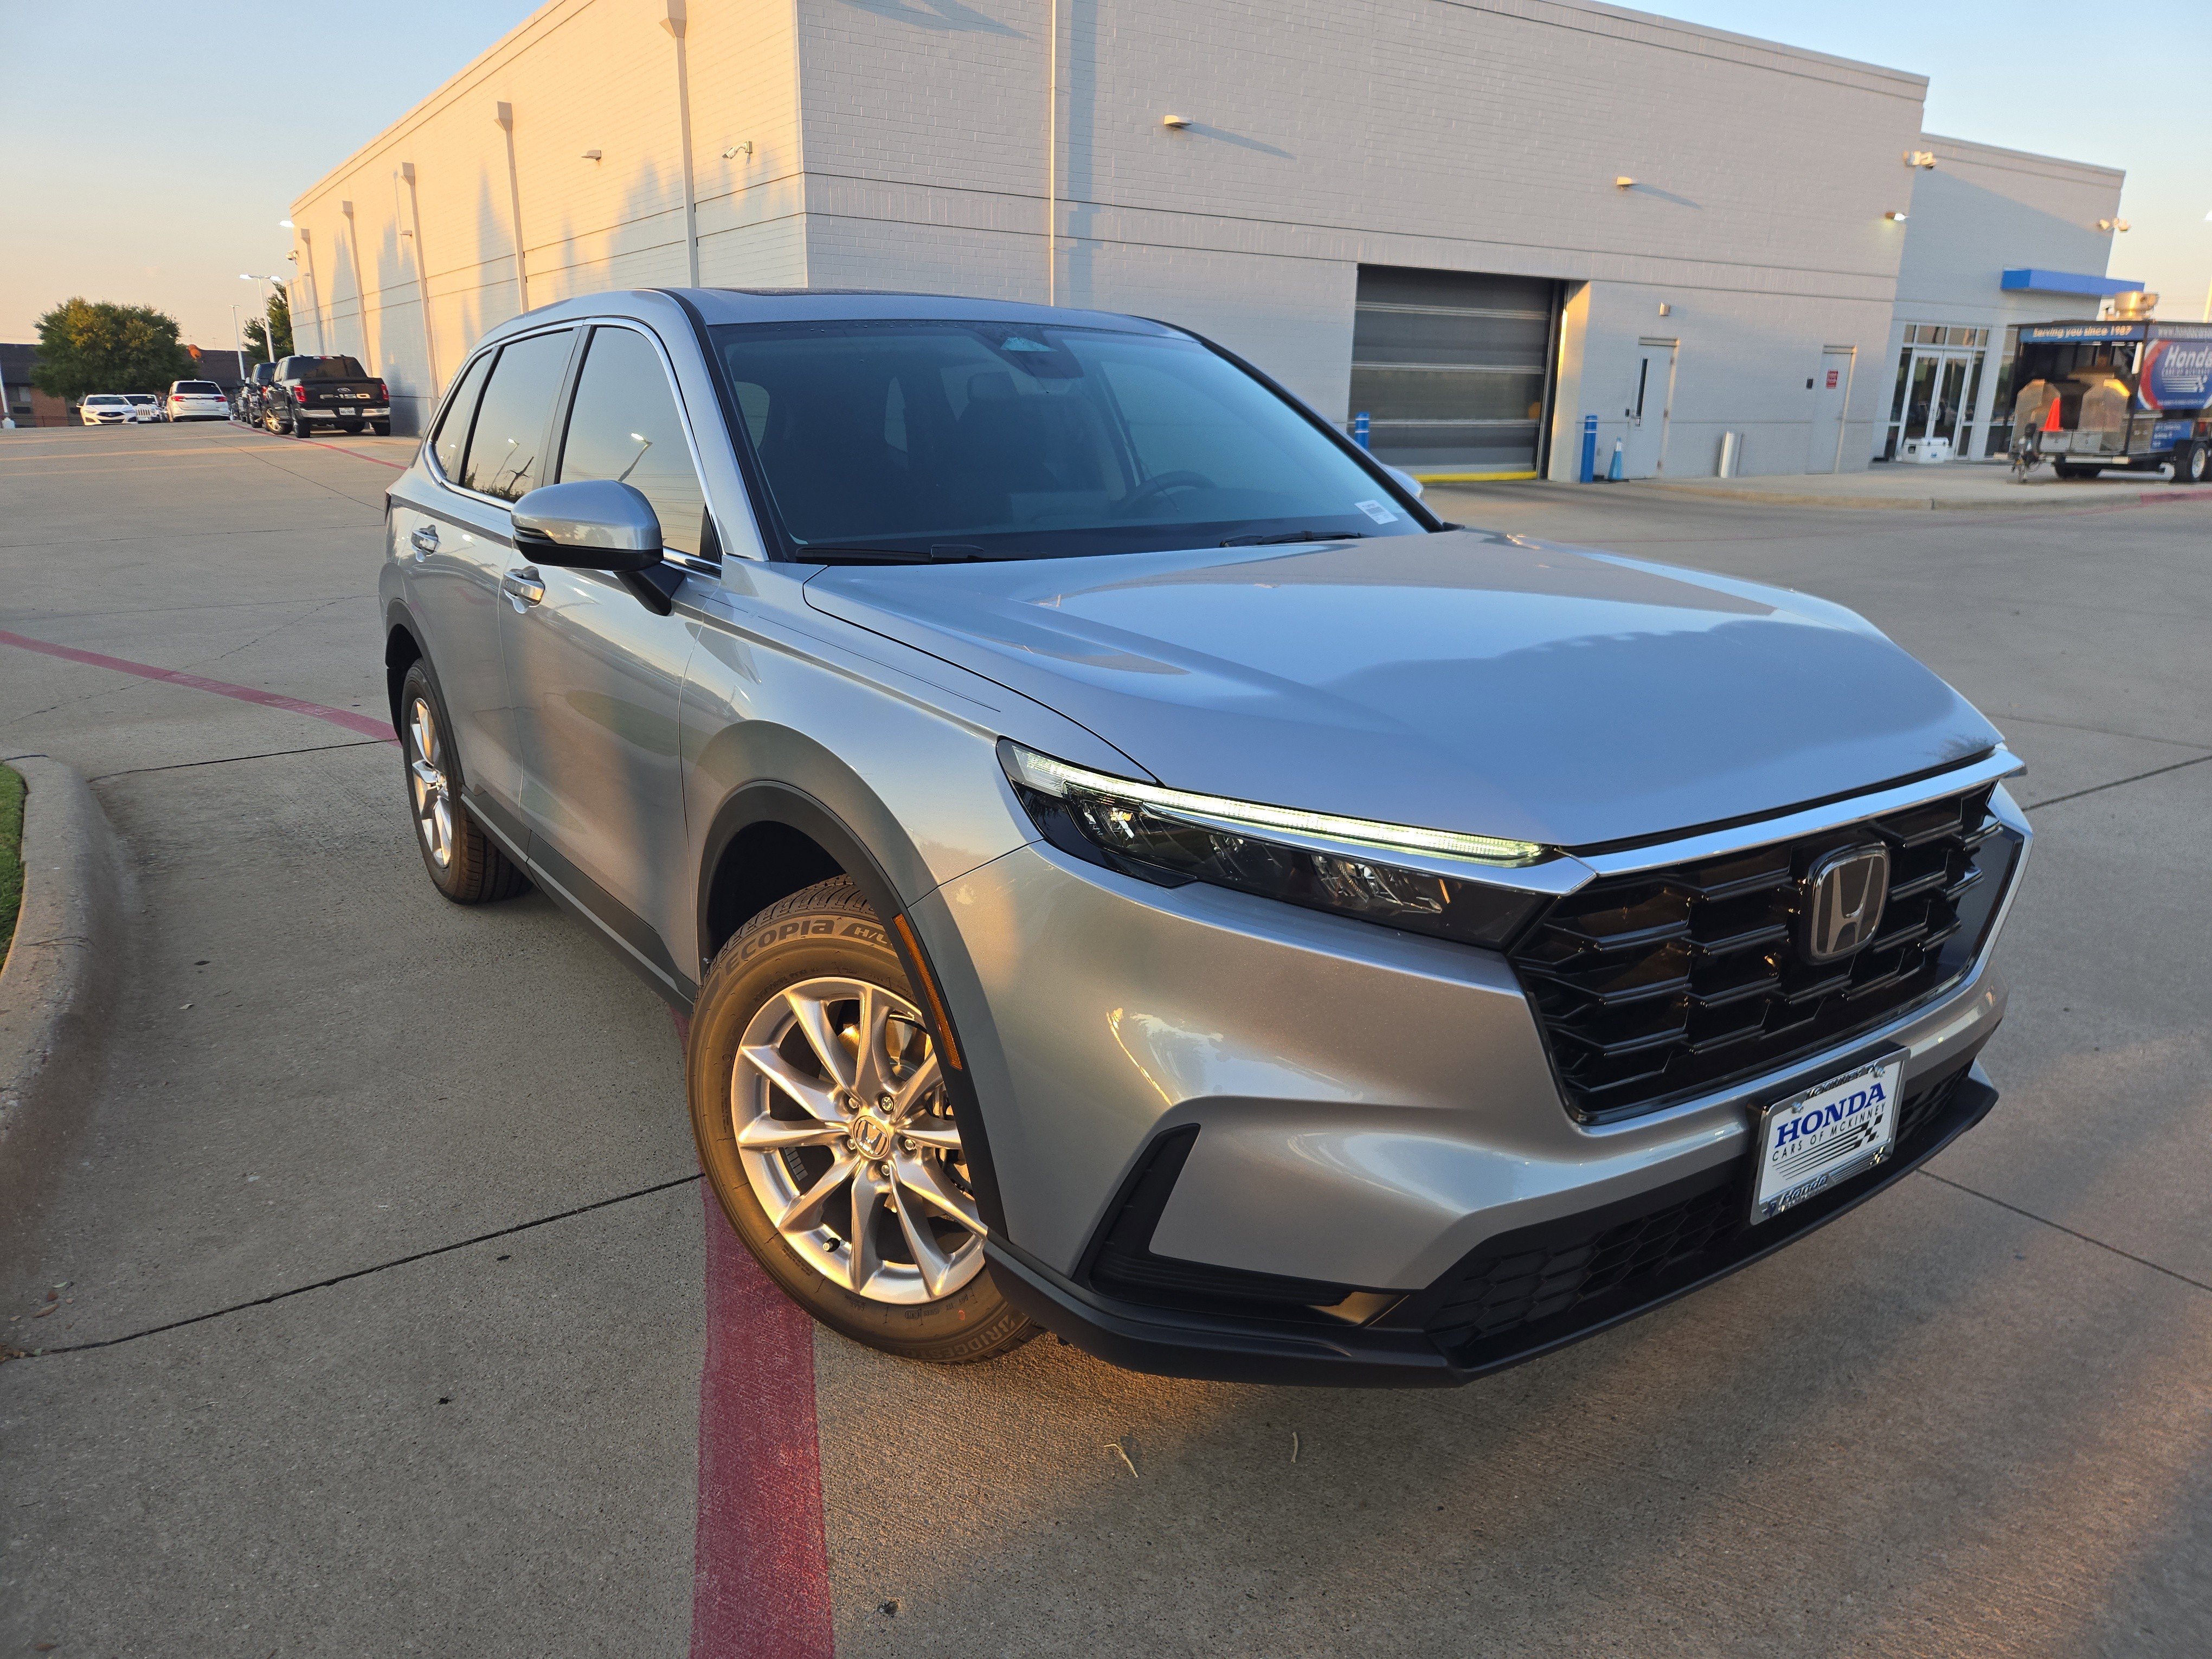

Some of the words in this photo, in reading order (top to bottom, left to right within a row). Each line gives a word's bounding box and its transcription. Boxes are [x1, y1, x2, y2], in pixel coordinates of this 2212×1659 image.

[2065, 327, 2084, 338] you
[2084, 326, 2108, 337] since
[1772, 1140, 1803, 1161] CARS
[1810, 1131, 1824, 1145] OF
[1830, 1102, 1886, 1137] MCKINNEY
[1774, 1082, 1886, 1148] HONDA
